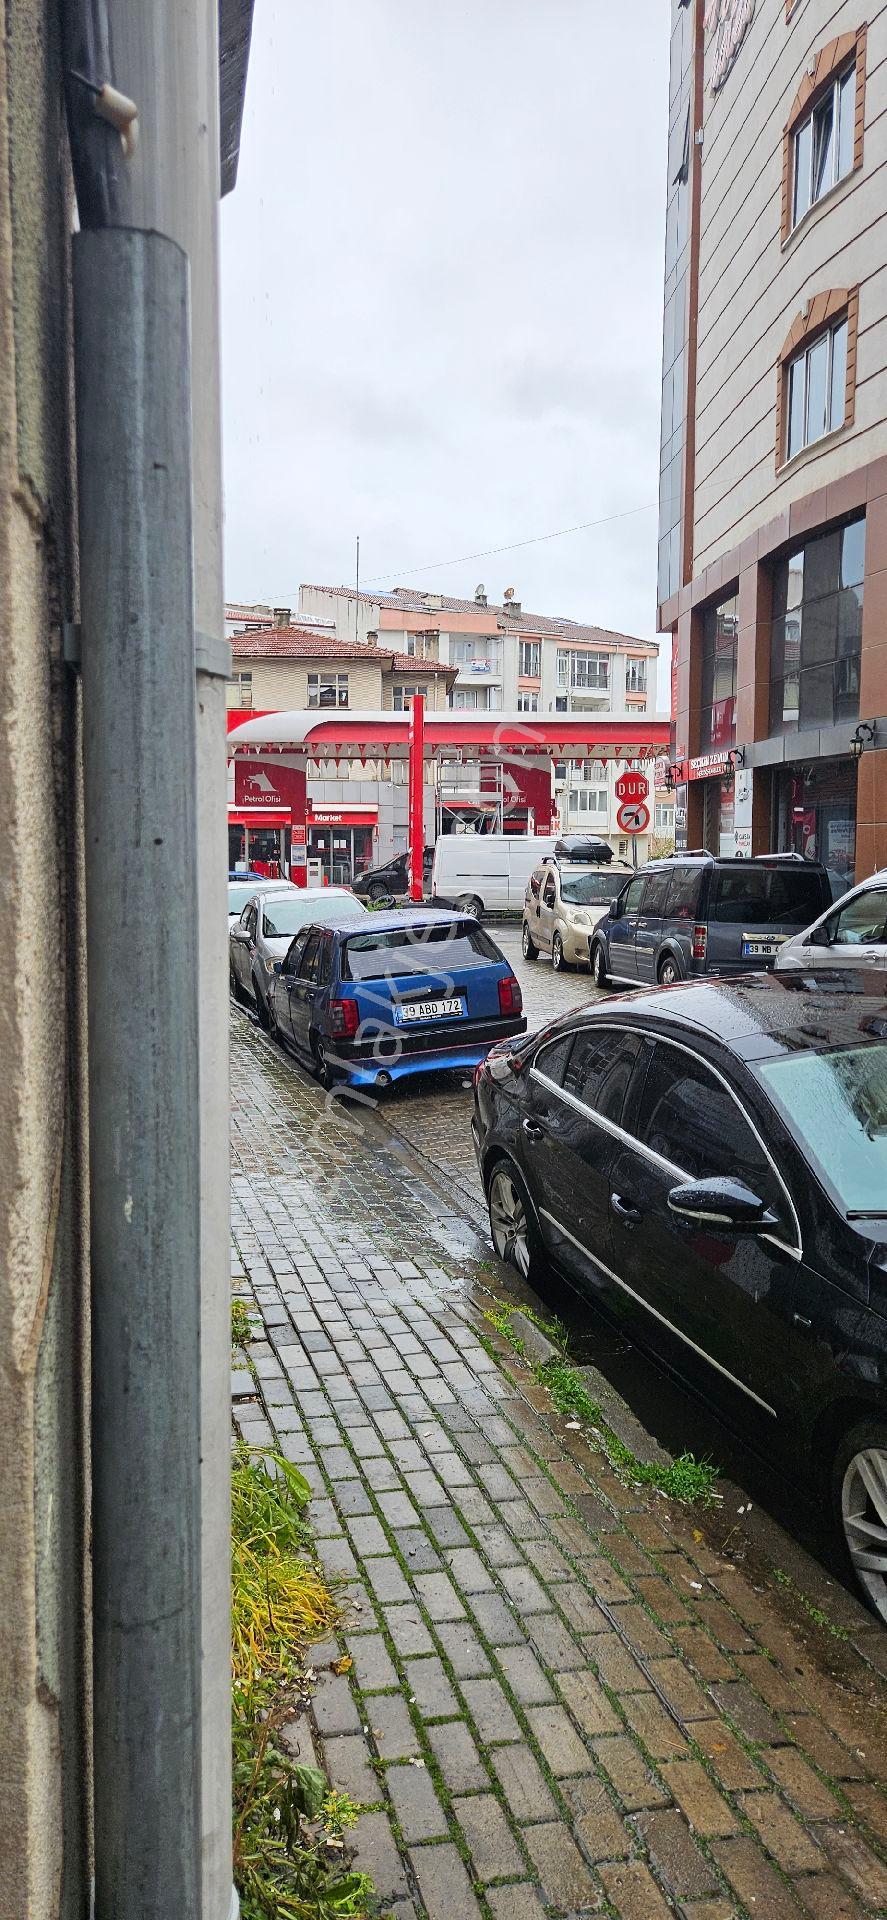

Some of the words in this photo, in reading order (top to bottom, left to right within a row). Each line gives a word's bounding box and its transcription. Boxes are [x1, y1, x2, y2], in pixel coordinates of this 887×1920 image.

[618, 782, 646, 795] DUR
[244, 795, 264, 803] Petrol
[265, 795, 281, 803] Ofisi
[510, 795, 526, 803] Ofisi
[314, 813, 342, 822] Market
[749, 944, 759, 953] 39
[402, 1006, 416, 1018] 39
[442, 1000, 460, 1012] 172
